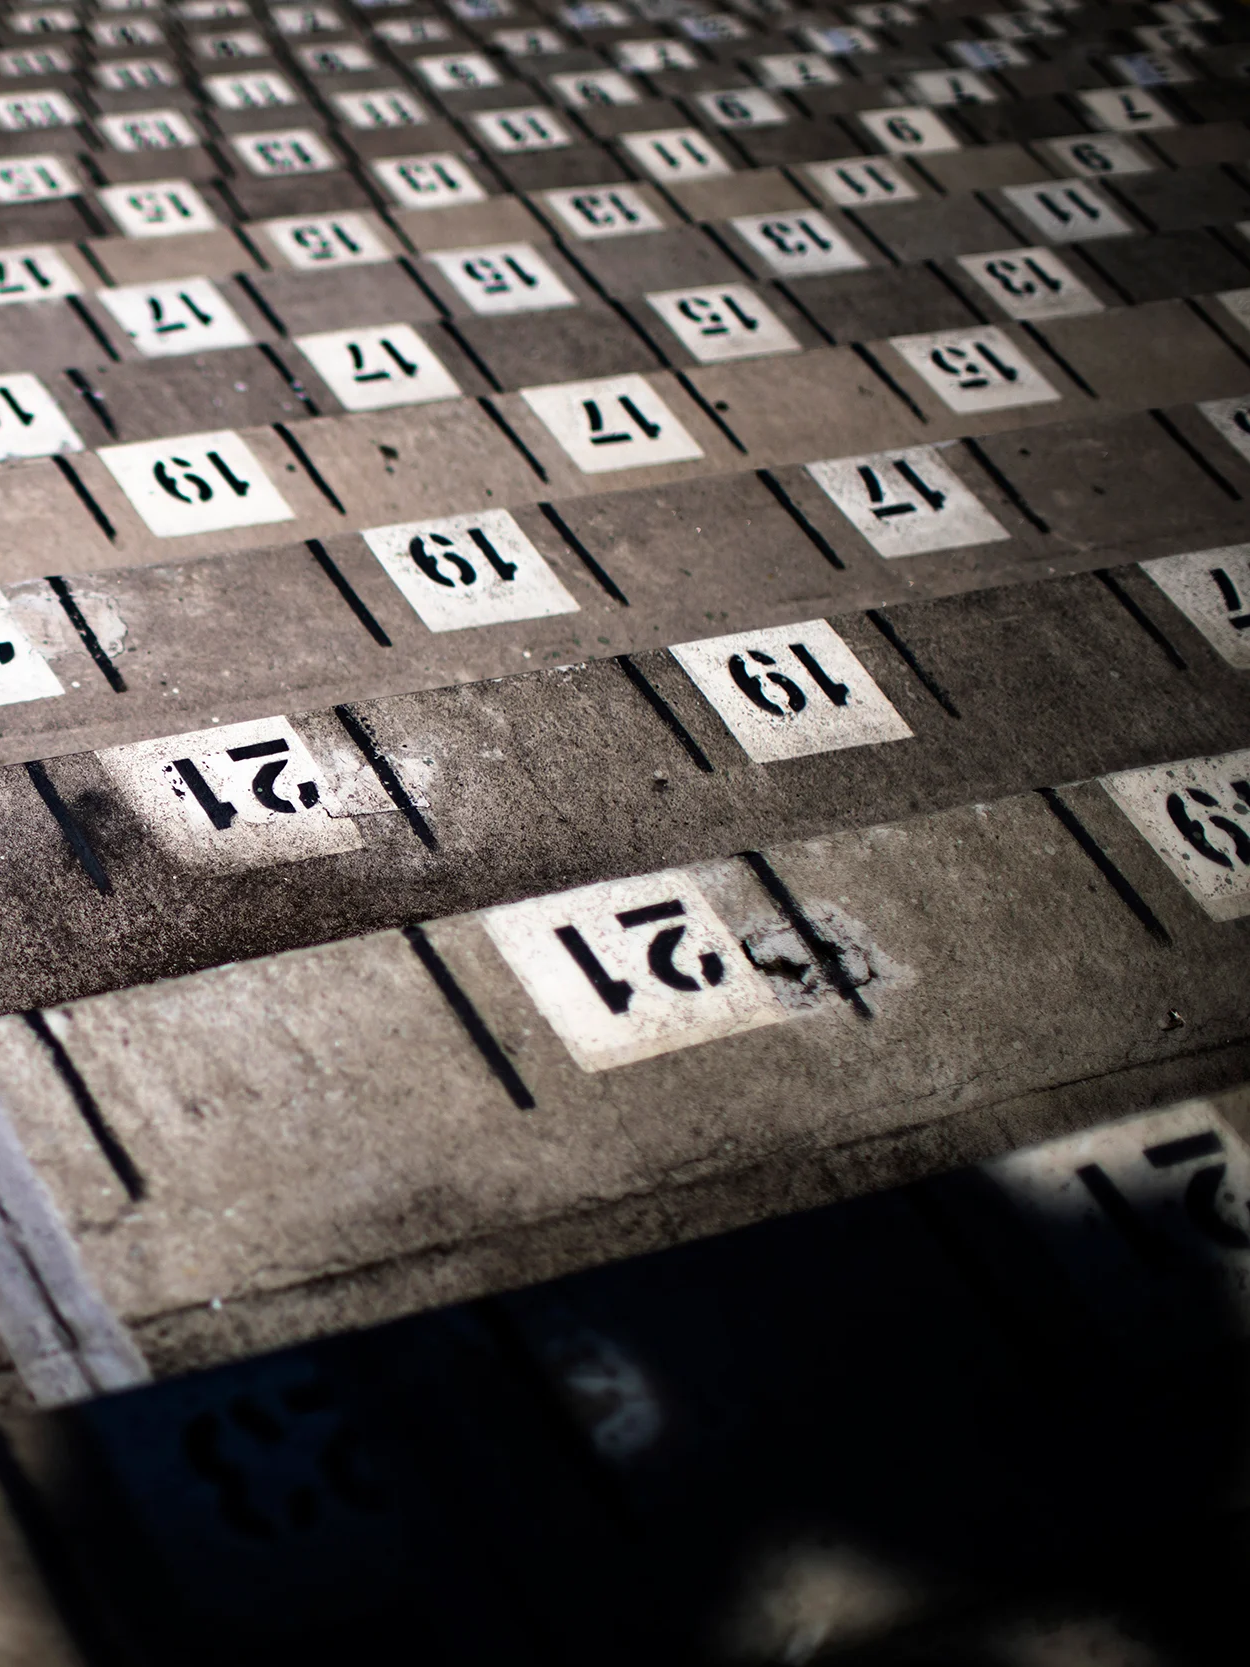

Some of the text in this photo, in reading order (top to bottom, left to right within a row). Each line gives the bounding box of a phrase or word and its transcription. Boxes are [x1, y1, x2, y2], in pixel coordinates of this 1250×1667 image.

[362, 97, 416, 125] 11
[716, 96, 751, 121] 9
[1120, 93, 1152, 119] 7
[500, 115, 549, 141] 11
[886, 117, 923, 142] 9
[255, 140, 313, 170] 13
[650, 138, 708, 168] 11
[1070, 143, 1112, 171] 9
[0, 165, 60, 196] 15
[398, 162, 459, 192] 13
[835, 164, 895, 196] 11
[129, 191, 192, 223] 15
[571, 192, 639, 225] 13
[1036, 188, 1101, 223] 11
[292, 223, 362, 260] 15
[760, 218, 833, 254] 13
[462, 255, 537, 295] 15
[985, 255, 1063, 297] 13
[148, 292, 213, 334] 17
[678, 296, 758, 336] 15
[348, 338, 419, 383] 17
[931, 342, 1019, 391] 15
[583, 395, 663, 446] 17
[153, 451, 250, 504] 19
[857, 459, 948, 521] 17
[408, 528, 518, 589] 19
[728, 643, 850, 716] 19
[172, 738, 321, 831] 21
[1166, 780, 1250, 870] 9
[553, 899, 726, 1016] 21
[1076, 1131, 1250, 1276] 21
